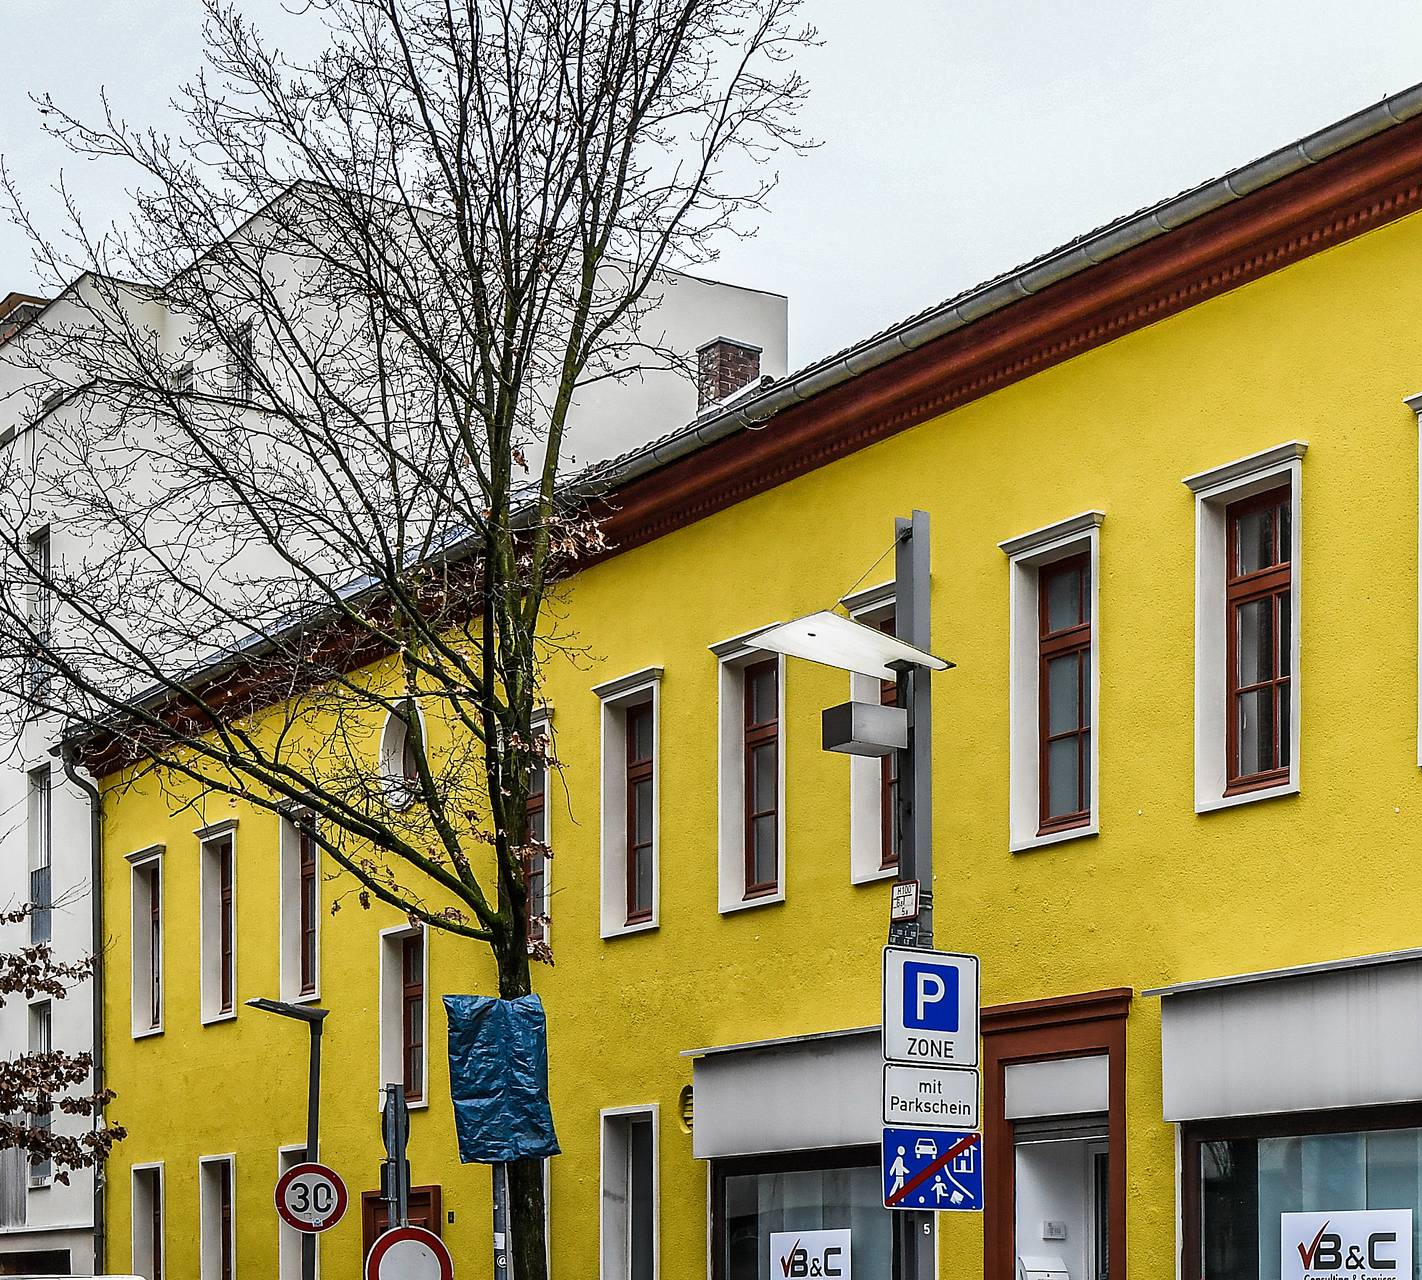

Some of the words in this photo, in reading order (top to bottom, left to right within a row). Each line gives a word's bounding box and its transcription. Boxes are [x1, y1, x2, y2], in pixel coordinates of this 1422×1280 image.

[916, 971, 946, 1021] P
[907, 1037, 954, 1059] ZONE
[919, 1079, 942, 1095] mit
[890, 1096, 971, 1116] Parkschein
[290, 1182, 332, 1213] 30
[923, 1223, 931, 1235] 5
